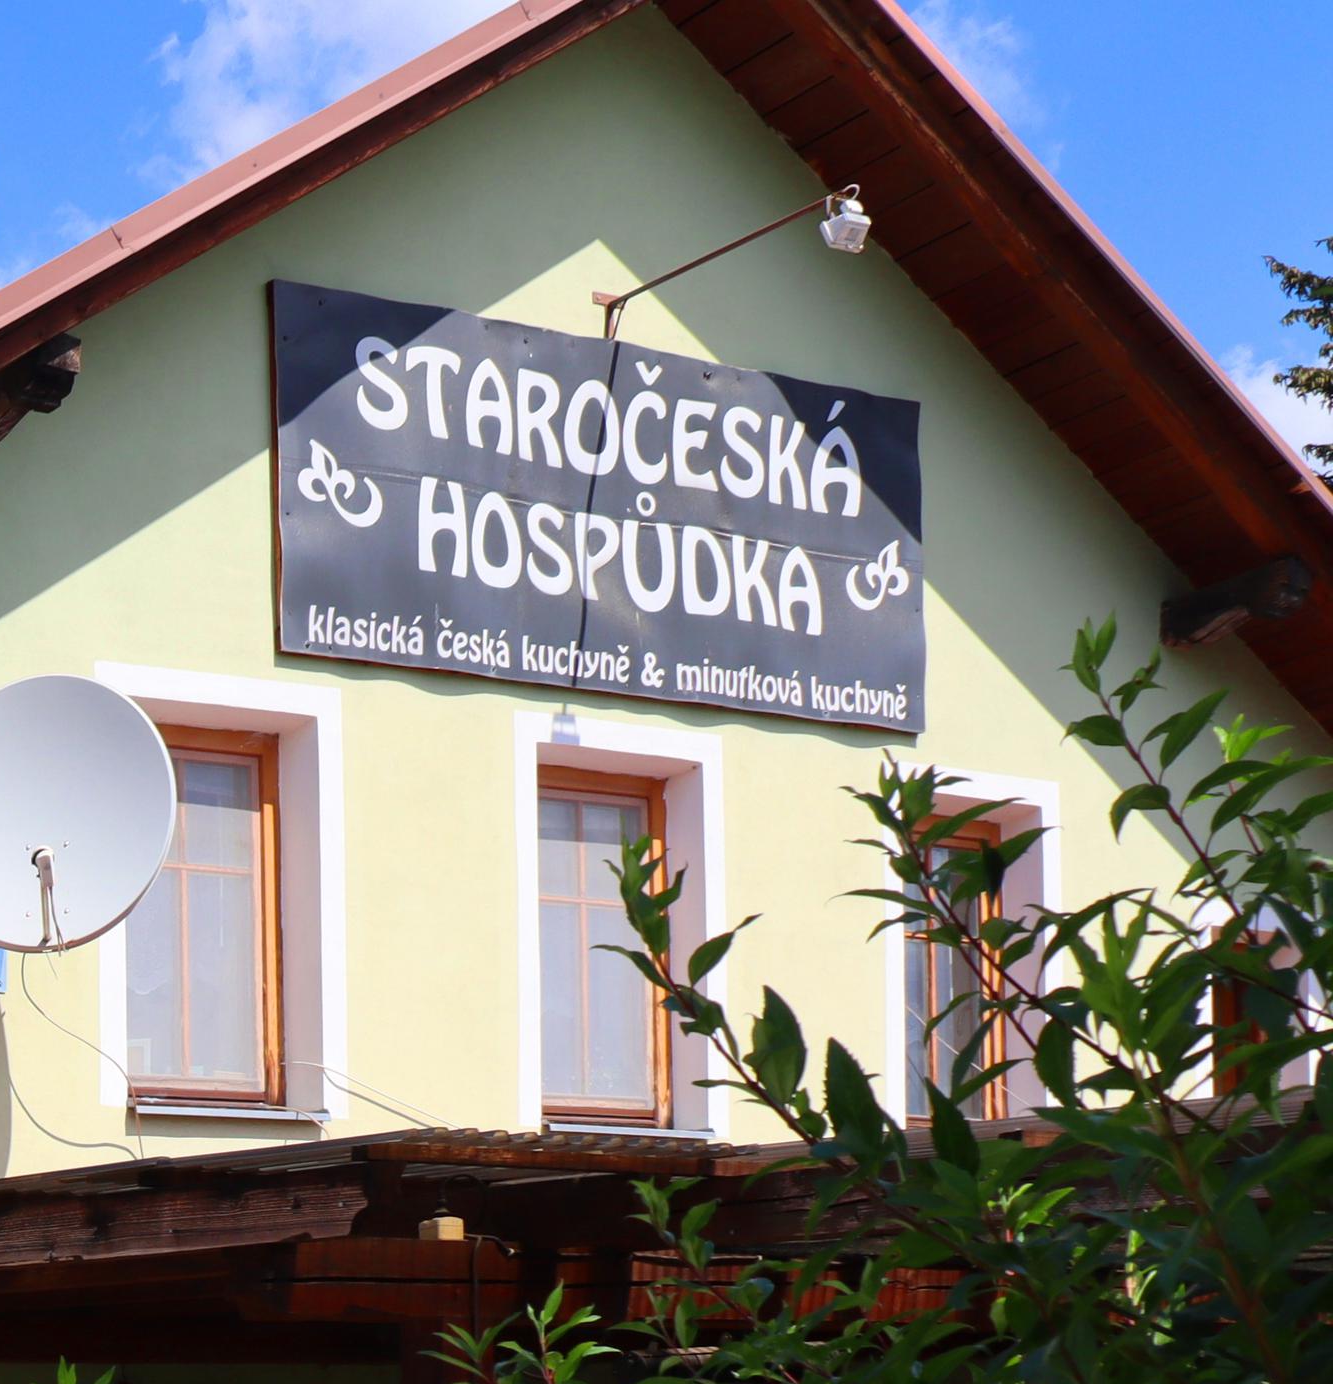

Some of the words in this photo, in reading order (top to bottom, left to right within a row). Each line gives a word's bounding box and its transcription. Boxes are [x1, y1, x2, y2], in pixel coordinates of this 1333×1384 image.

[355, 336, 862, 517] STAROČESKÁ
[417, 476, 822, 636] HOSPŮDKA
[308, 605, 424, 656] klasická
[437, 618, 510, 669] česká
[522, 633, 630, 688] kuchyně
[641, 652, 664, 689] &
[676, 660, 803, 707] minutková
[811, 676, 907, 721] kuchyně
